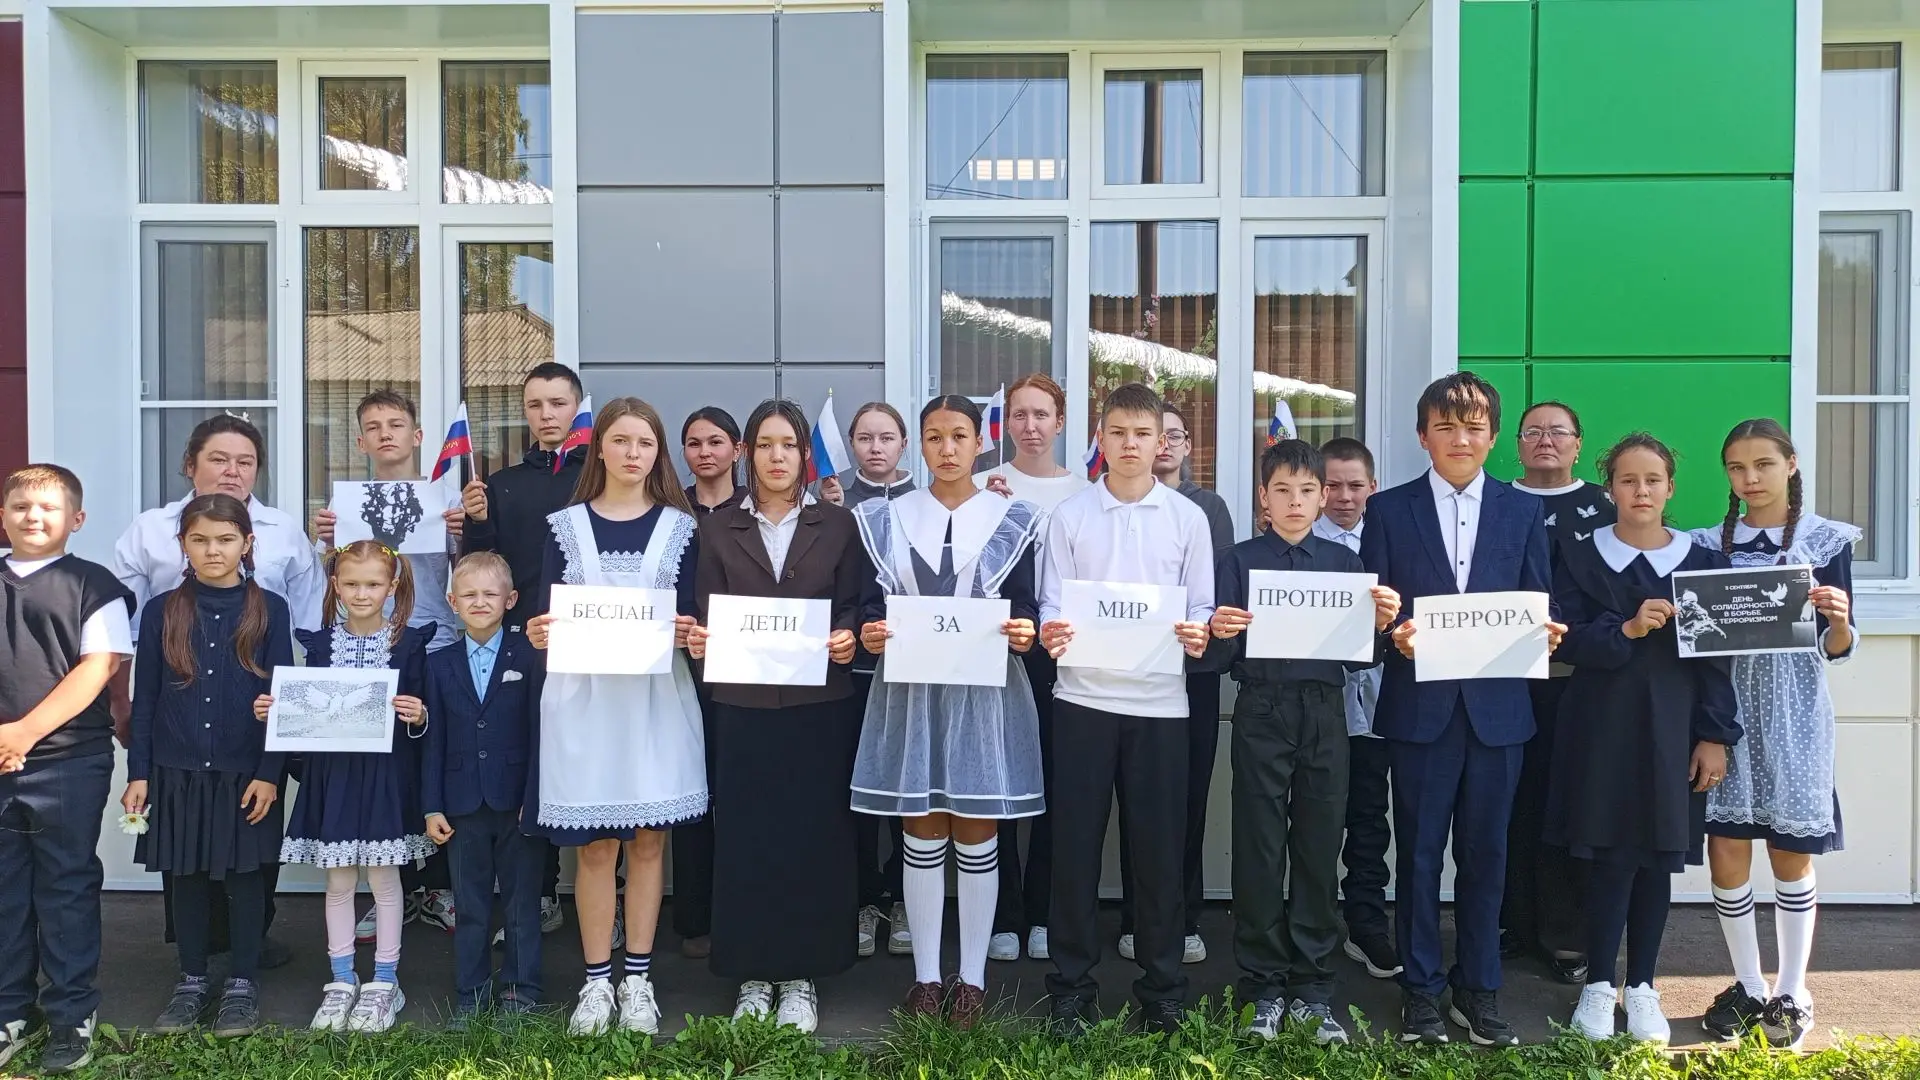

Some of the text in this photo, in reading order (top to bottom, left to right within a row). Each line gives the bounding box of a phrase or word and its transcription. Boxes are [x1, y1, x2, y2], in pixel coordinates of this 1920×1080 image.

[1257, 588, 1353, 608] ПРОТИВ
[1711, 602, 1776, 611] СОЛИДАРНОСТИ
[572, 603, 656, 621] БЕСЛАН
[1098, 600, 1149, 620] МИР
[1425, 608, 1536, 630] ТЕРРОРА
[740, 614, 798, 634] ДЕТИ
[933, 614, 962, 633] ЗА
[1719, 615, 1778, 625] ТЕРРОРИЗМОМ
